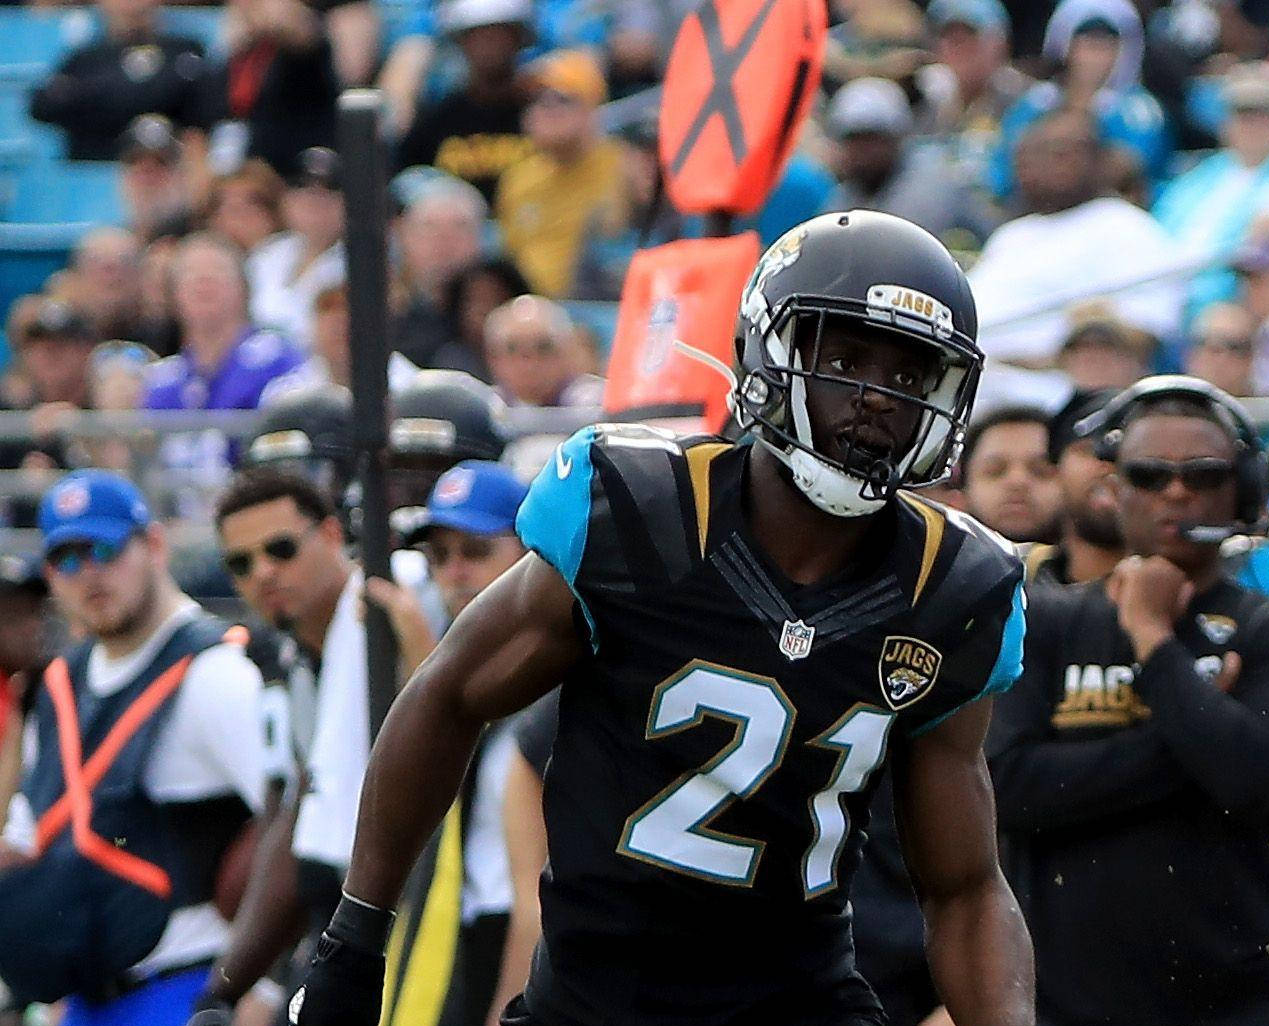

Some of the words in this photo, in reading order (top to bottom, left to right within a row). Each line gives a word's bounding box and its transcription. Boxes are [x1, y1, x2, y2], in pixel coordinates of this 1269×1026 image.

[890, 290, 934, 317] JAGS
[885, 641, 936, 676] JAGS
[615, 657, 898, 901] 21
